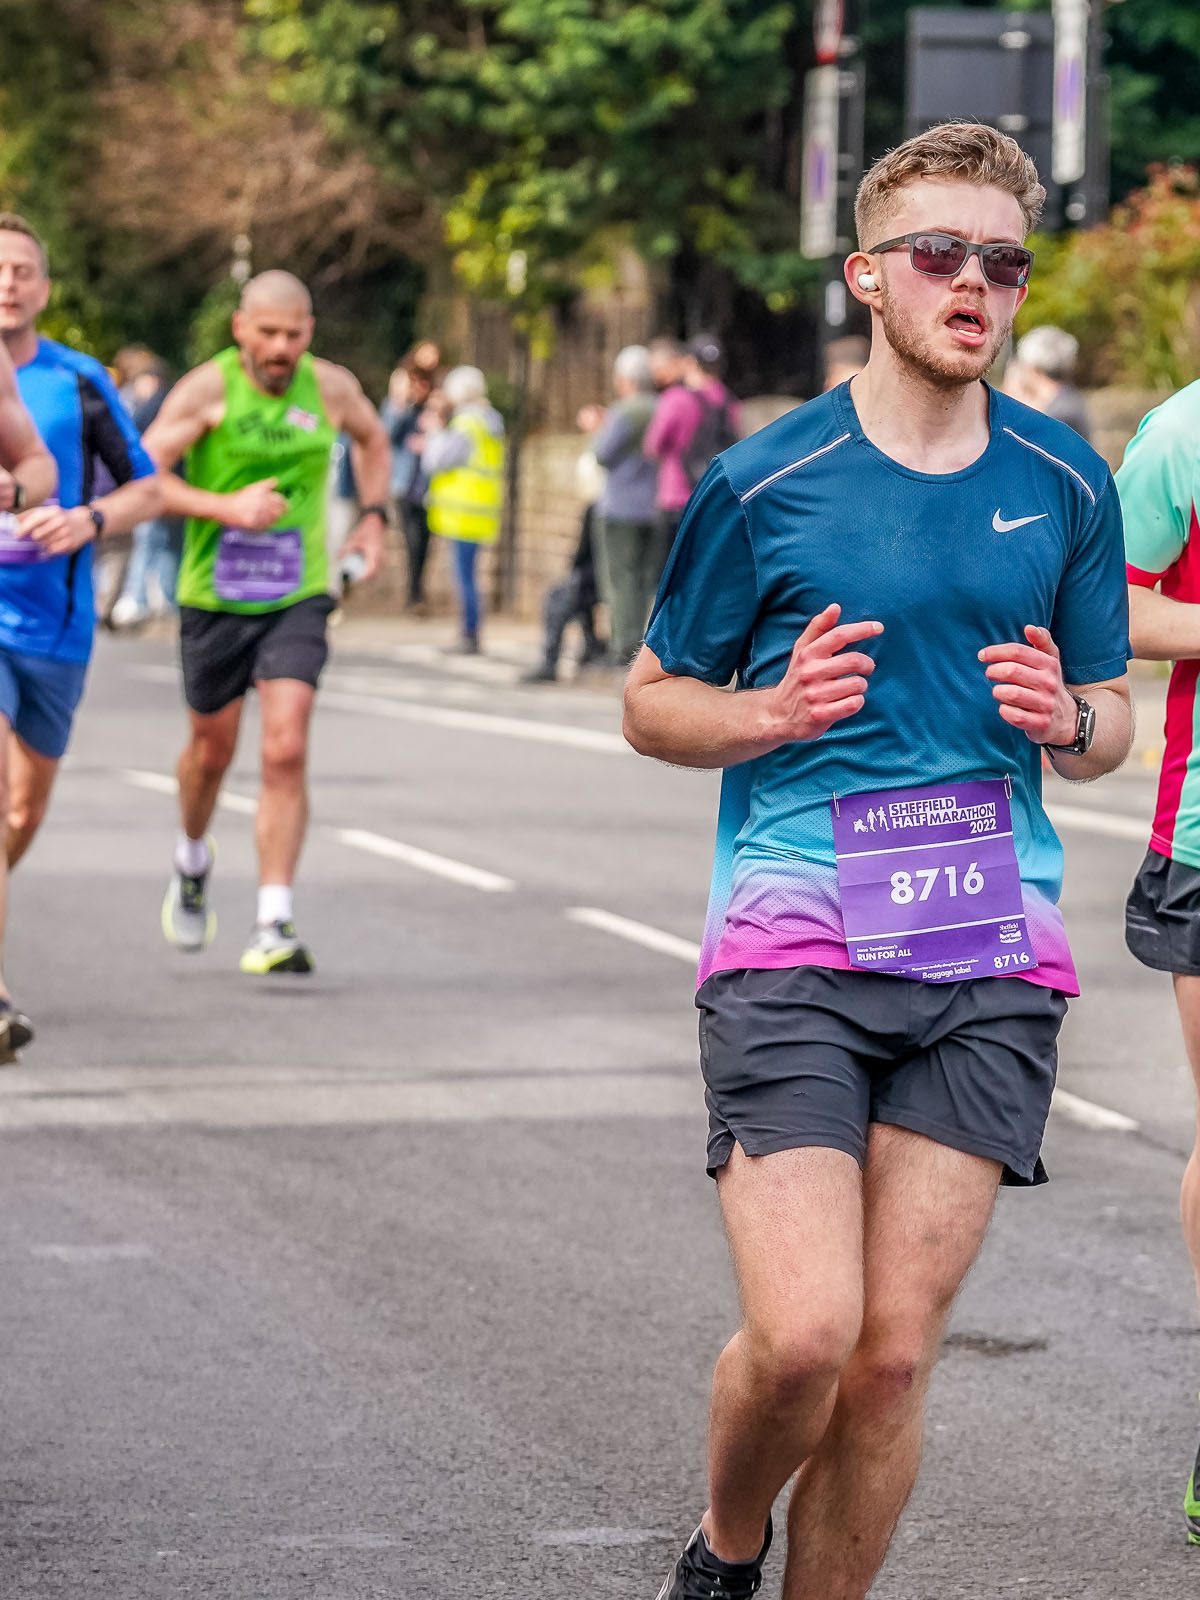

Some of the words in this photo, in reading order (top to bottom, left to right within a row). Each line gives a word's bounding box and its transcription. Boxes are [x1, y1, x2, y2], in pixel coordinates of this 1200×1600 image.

[891, 798, 954, 816] SHEFFIELD
[892, 813, 927, 829] HALF
[929, 804, 995, 825] MARATHON
[969, 818, 997, 834] 2022
[890, 862, 984, 905] 8716
[857, 952, 877, 961] RUN
[877, 950, 896, 960] FOR
[897, 948, 912, 957] ALL
[993, 951, 1030, 969] 8716
[922, 970, 954, 980] Baggage
[954, 965, 972, 975] label
